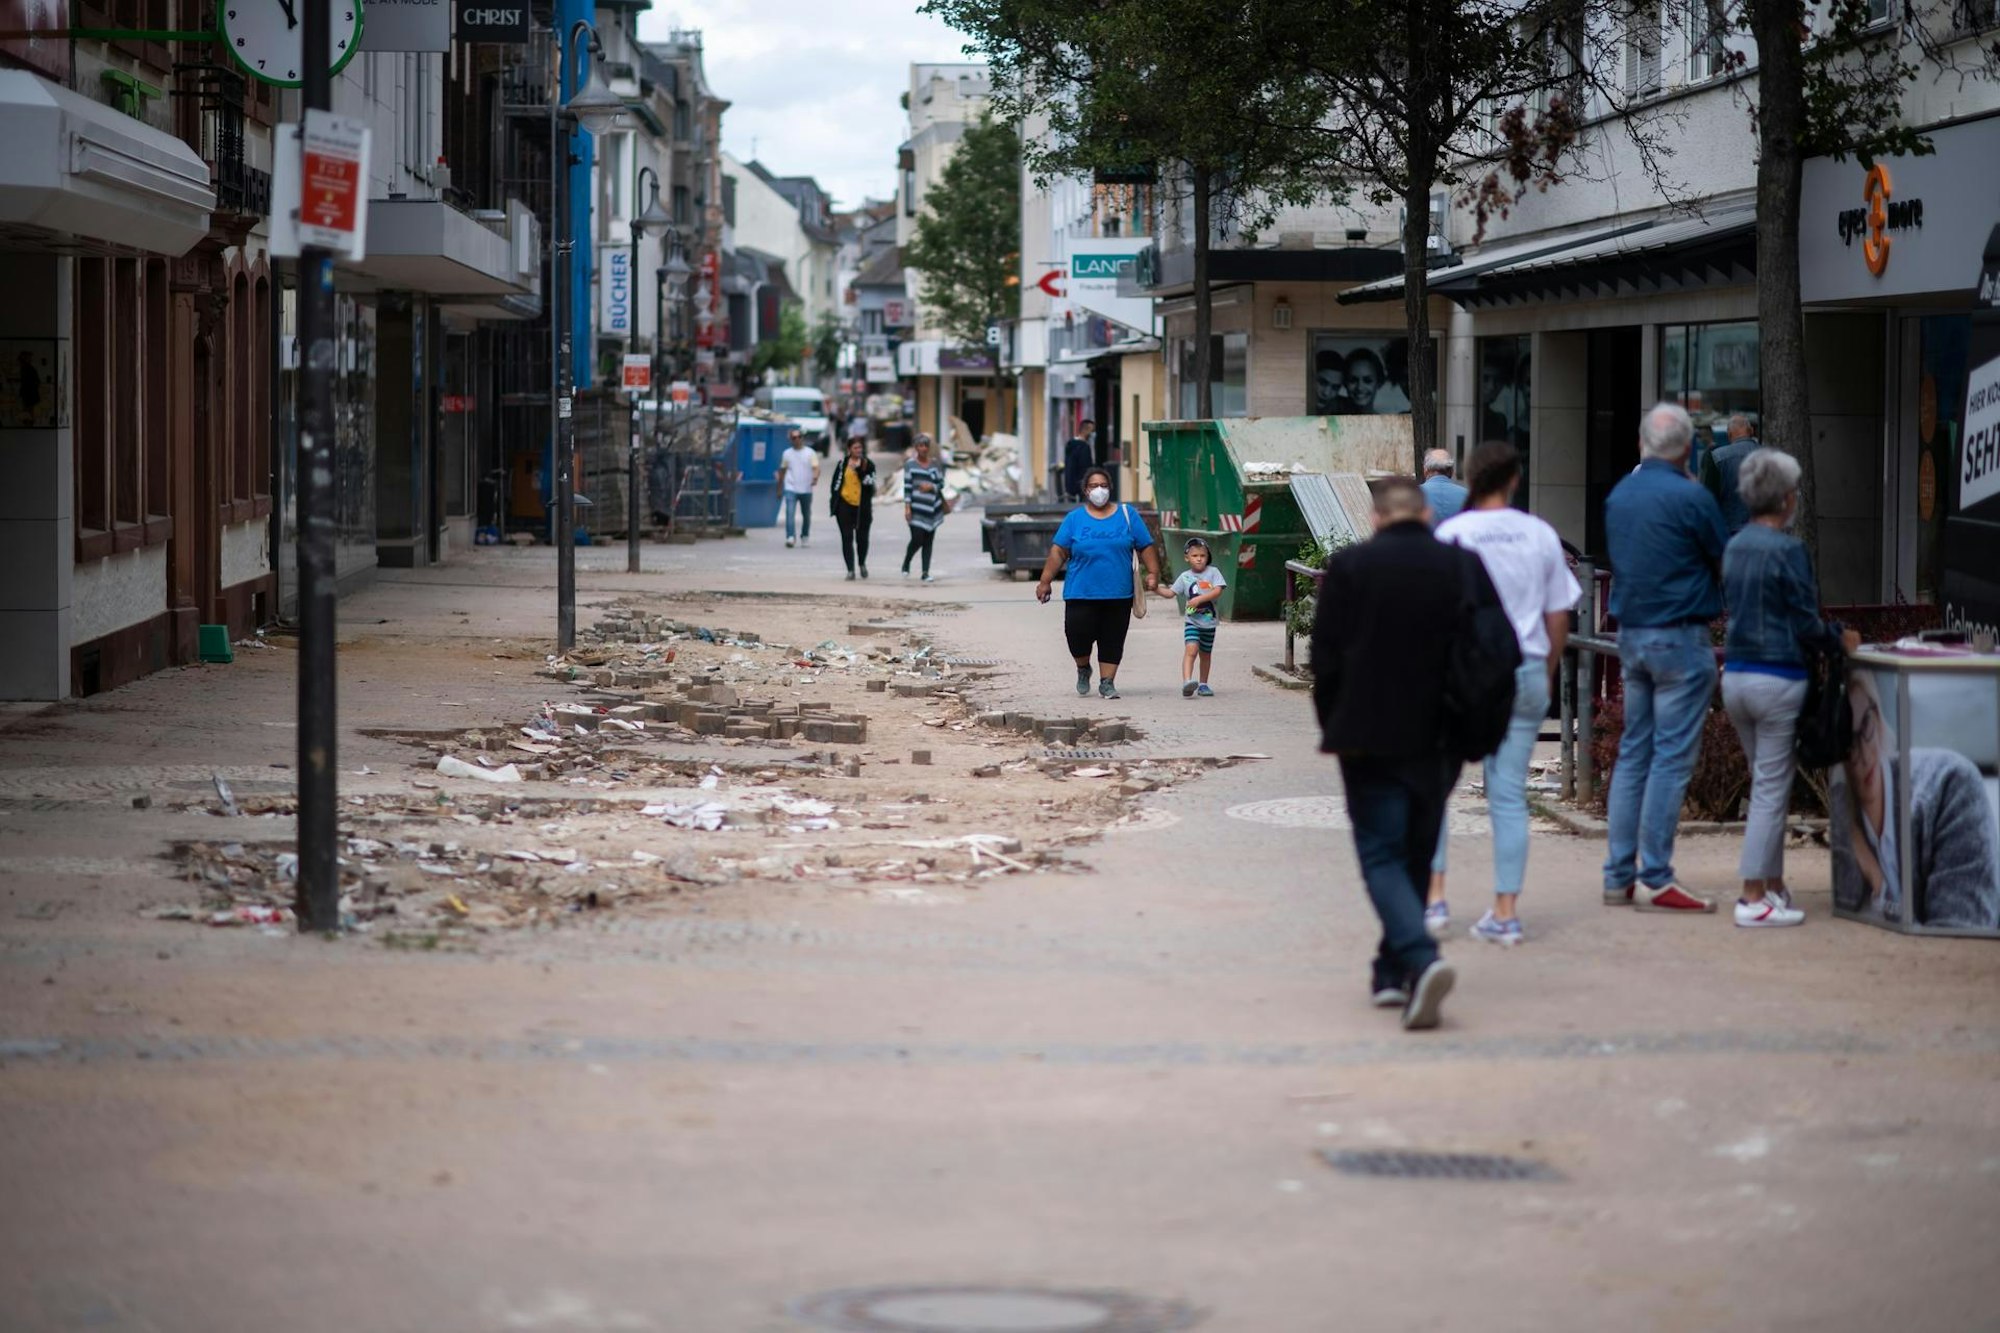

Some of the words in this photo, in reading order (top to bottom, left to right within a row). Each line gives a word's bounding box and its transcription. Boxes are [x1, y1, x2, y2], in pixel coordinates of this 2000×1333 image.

[228, 10, 236, 20] 9
[345, 11, 354, 21] 3
[463, 9, 522, 26] CHRIST
[236, 38, 245, 47] 8
[338, 40, 346, 50] 4
[258, 60, 266, 70] 7
[287, 69, 296, 79] 6
[1839, 208, 1867, 247] eyes
[1887, 198, 1923, 230] more
[608, 253, 627, 330] BÜCHER
[1969, 387, 1986, 416] HIER
